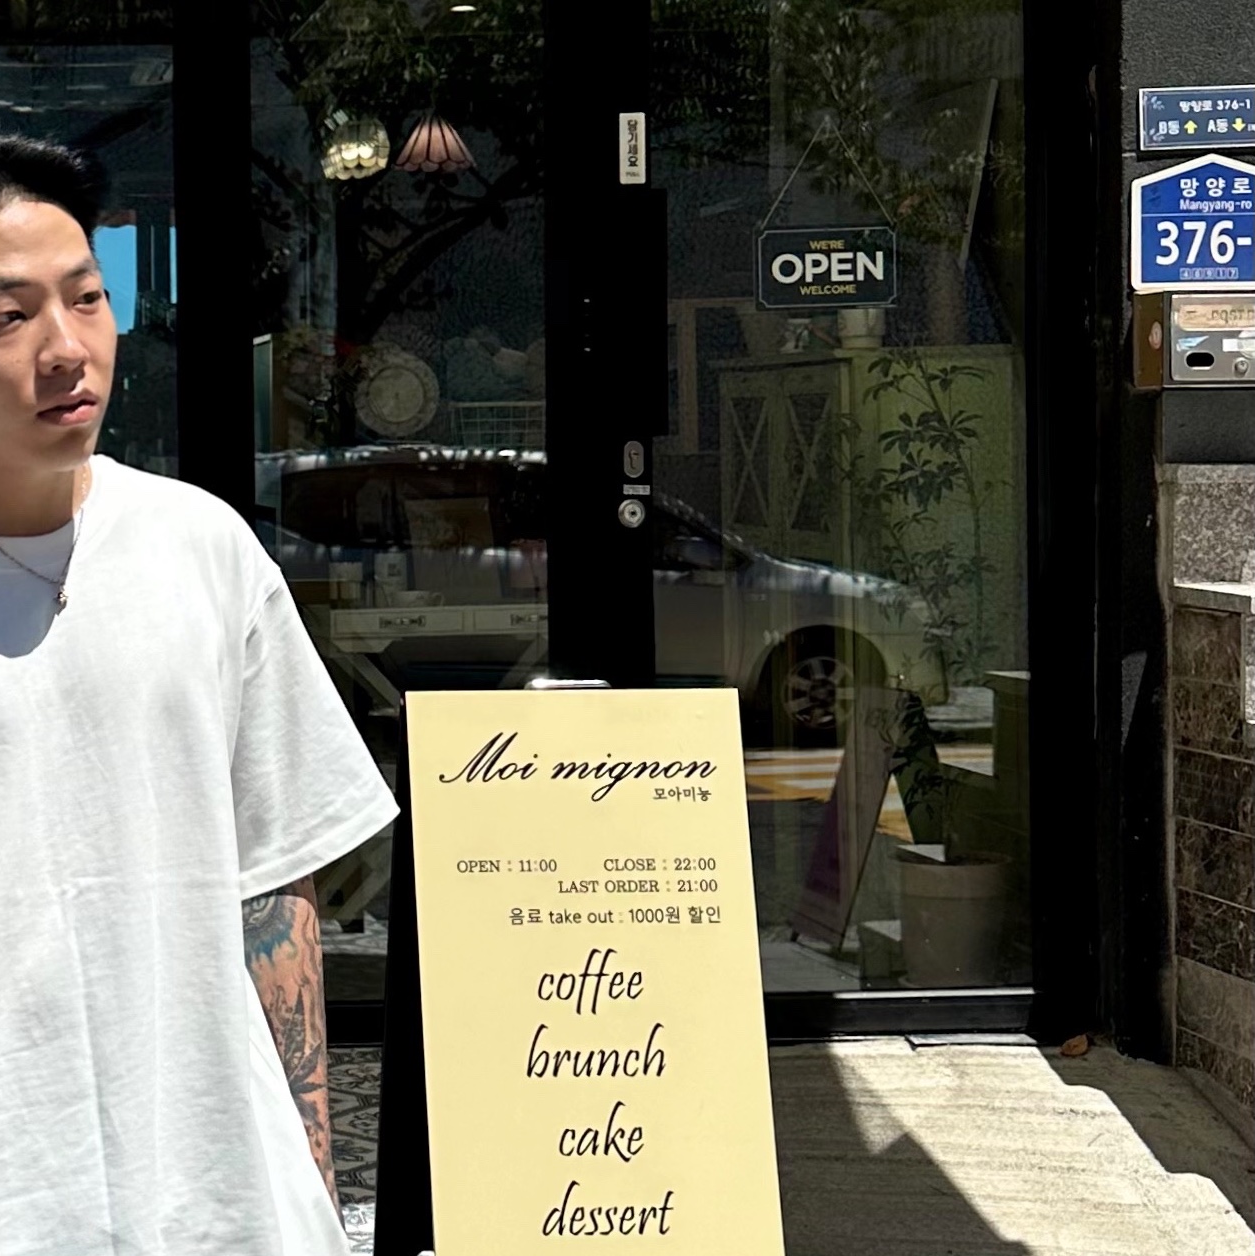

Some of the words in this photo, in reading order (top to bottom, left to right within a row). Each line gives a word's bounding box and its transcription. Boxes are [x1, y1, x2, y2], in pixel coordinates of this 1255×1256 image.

[1216, 99, 1251, 110] 376-1
[627, 119, 639, 167] 당기세요
[1179, 177, 1253, 198] 망양로
[1179, 199, 1253, 212] Mangyang-ro
[771, 251, 884, 284] OPEN
[800, 284, 857, 295] WELCOME
[438, 731, 539, 783] Moi
[550, 752, 717, 802] mignon
[456, 859, 501, 873] OPEN
[518, 859, 558, 873] 11:00
[603, 858, 657, 872] CLOSE
[673, 857, 717, 871] 22:00
[557, 880, 599, 894] LAST
[604, 879, 660, 893] ORDER
[677, 879, 719, 893] 21:00
[508, 907, 544, 926] 음료
[548, 908, 582, 924] take
[586, 909, 614, 924] out
[628, 905, 681, 924] 1000원
[687, 905, 721, 925] 할인
[537, 948, 644, 1015] coffee
[526, 1022, 666, 1078] brunch
[558, 1101, 645, 1163] cake
[541, 1180, 675, 1237] dessert
